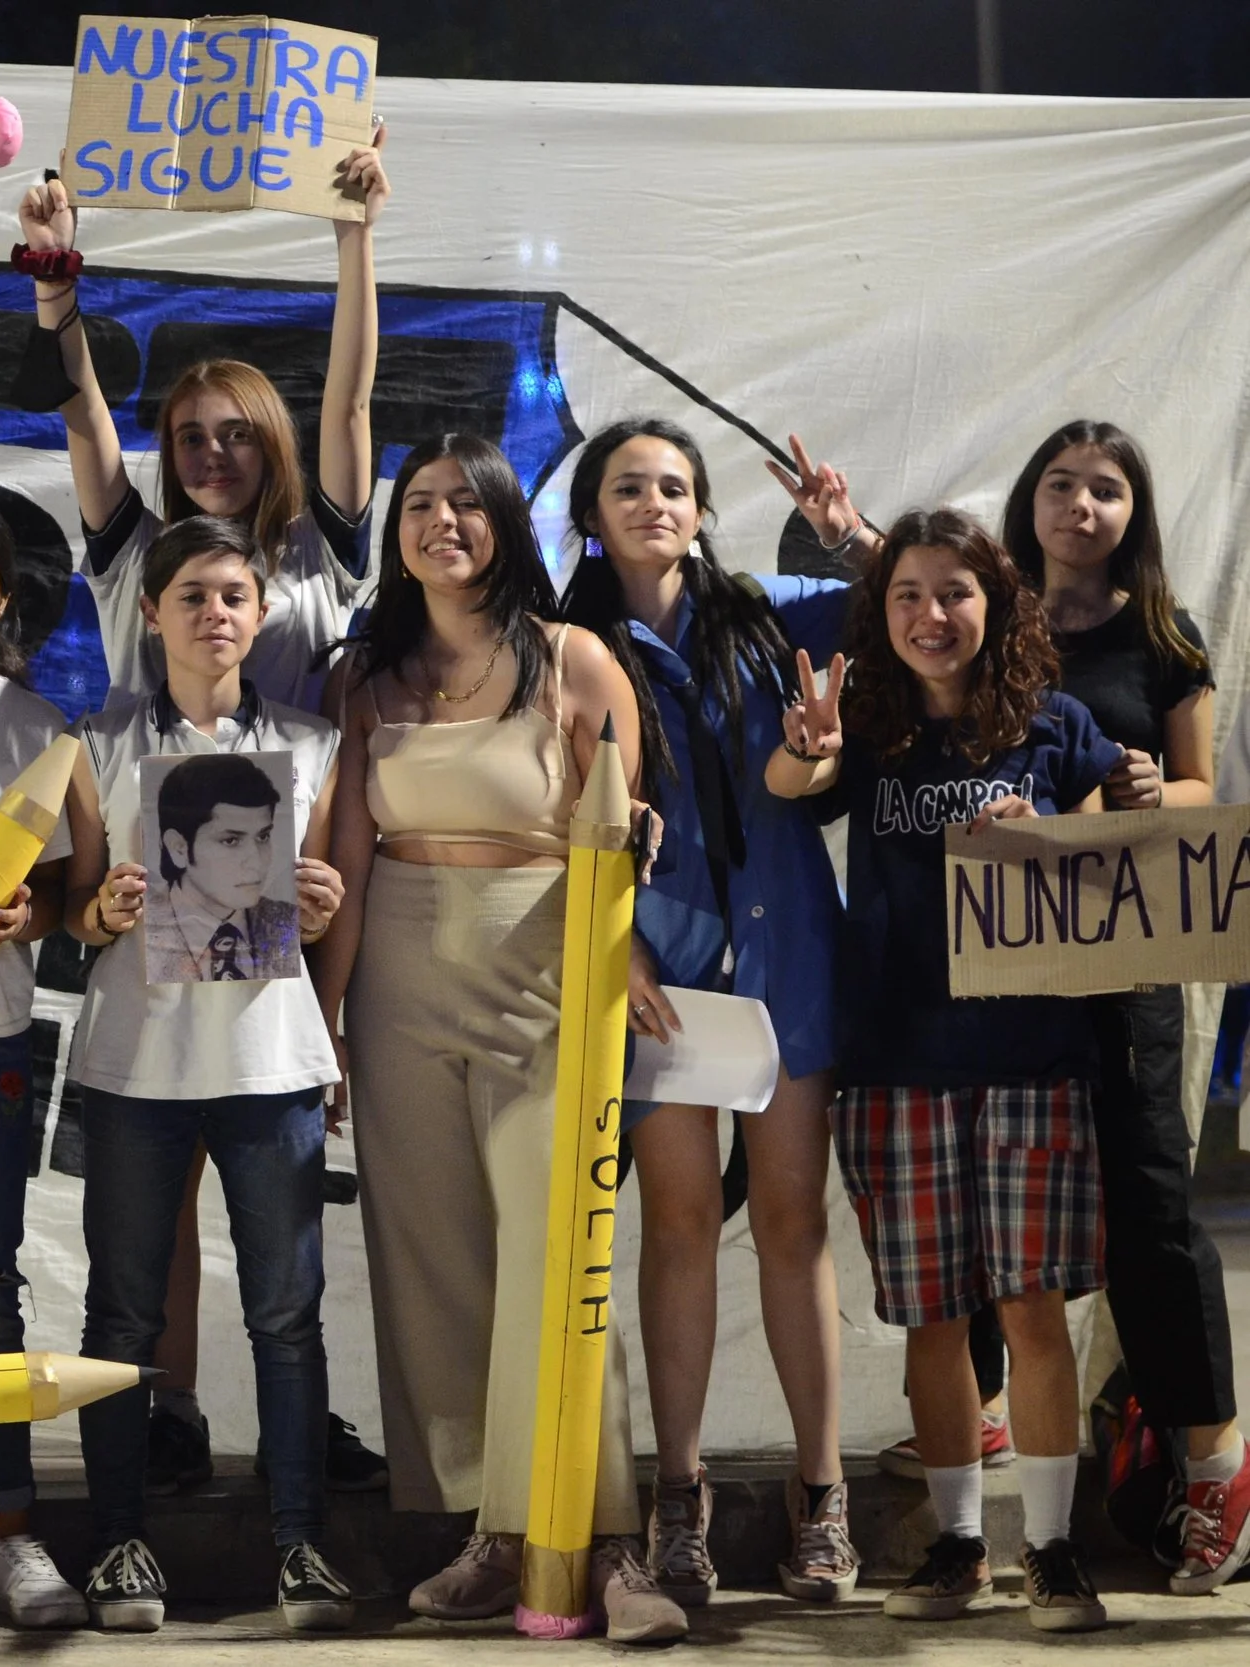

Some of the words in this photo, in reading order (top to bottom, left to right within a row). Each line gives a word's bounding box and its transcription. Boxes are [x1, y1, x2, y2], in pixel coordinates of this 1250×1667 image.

[77, 24, 369, 103] NUESTRA
[126, 82, 324, 148] LUCHA
[75, 139, 292, 198] SIGUE
[873, 777, 912, 836] LA
[954, 846, 1154, 955] NUNCA
